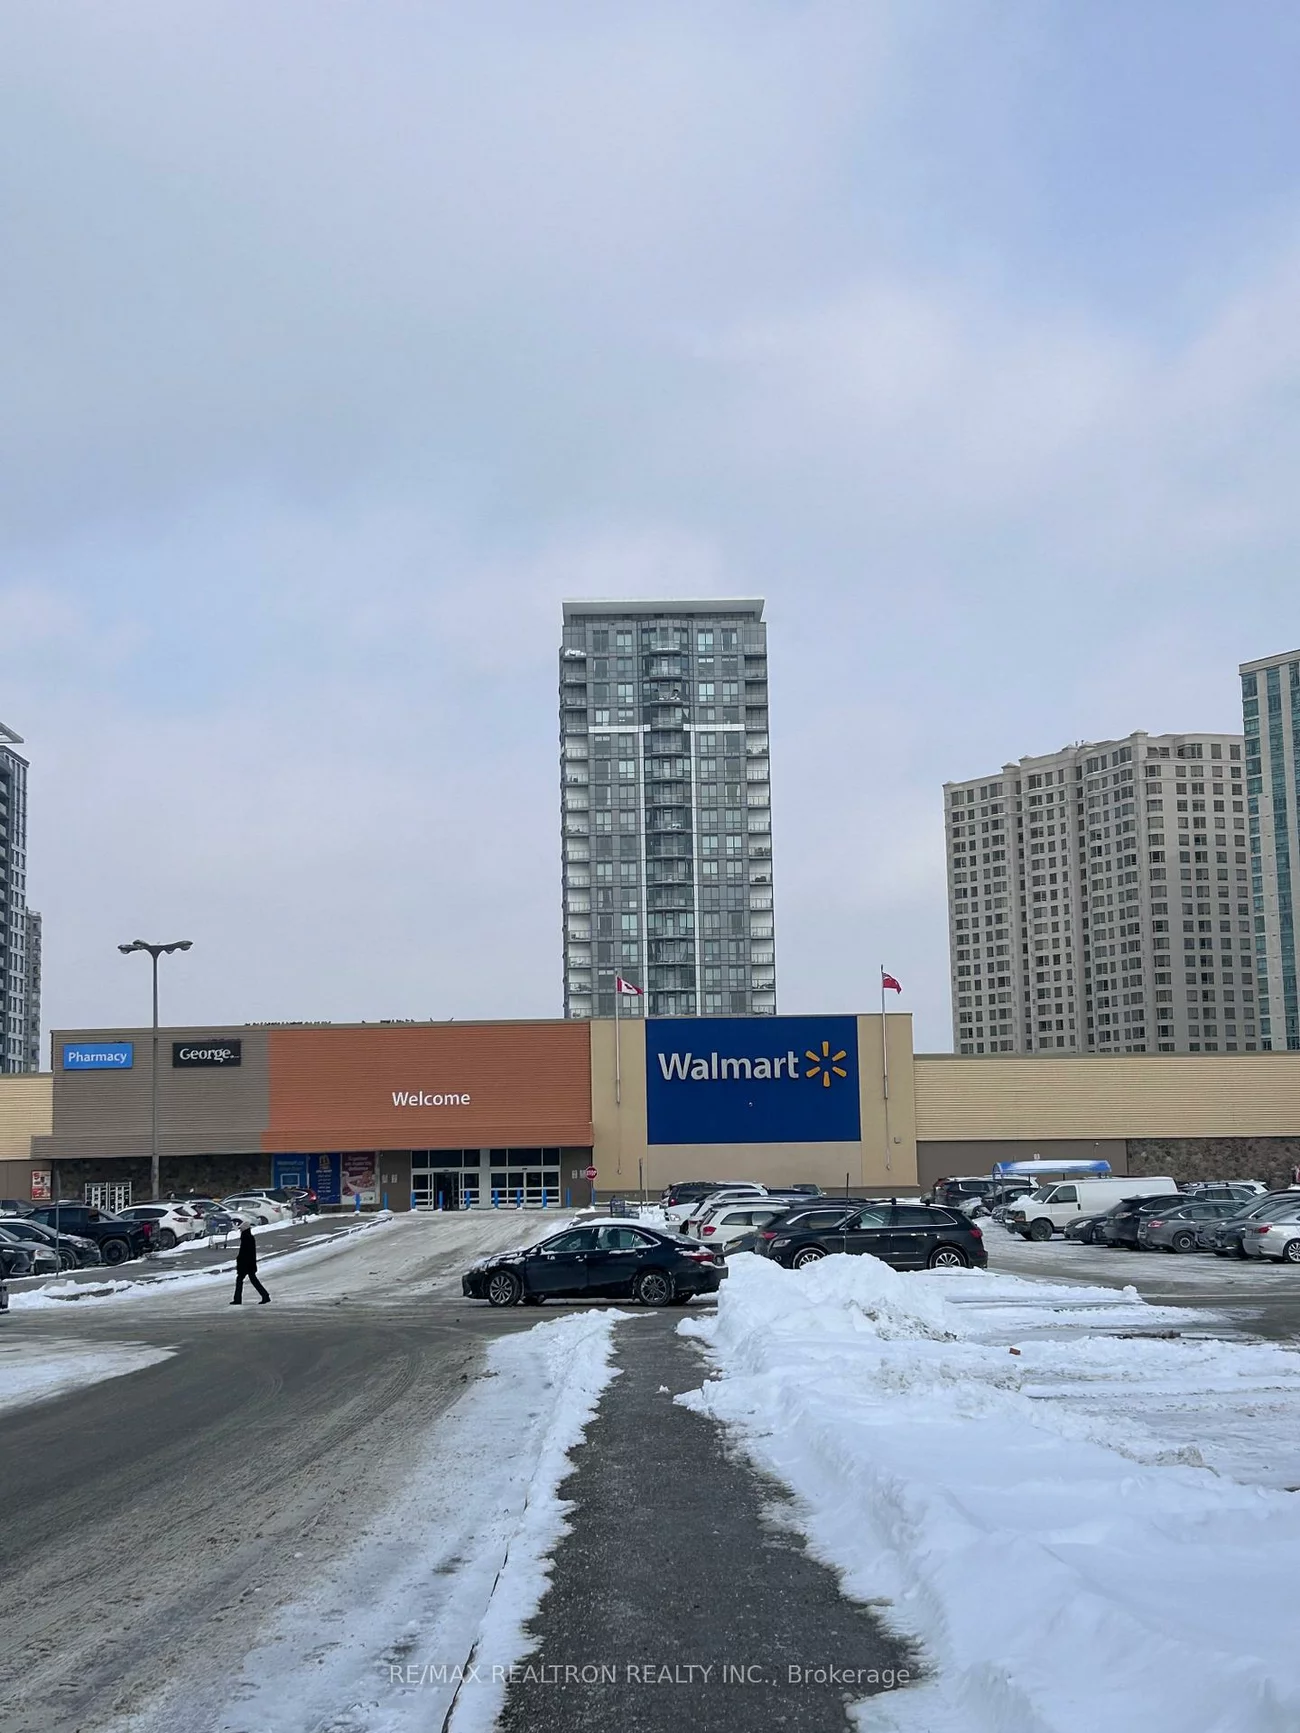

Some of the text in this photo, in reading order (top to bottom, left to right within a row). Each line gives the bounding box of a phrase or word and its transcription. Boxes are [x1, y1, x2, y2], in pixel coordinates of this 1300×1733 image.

[68, 1051, 127, 1064] Pharmacy
[658, 1051, 799, 1080] Walmart
[391, 1091, 471, 1106] Welcome
